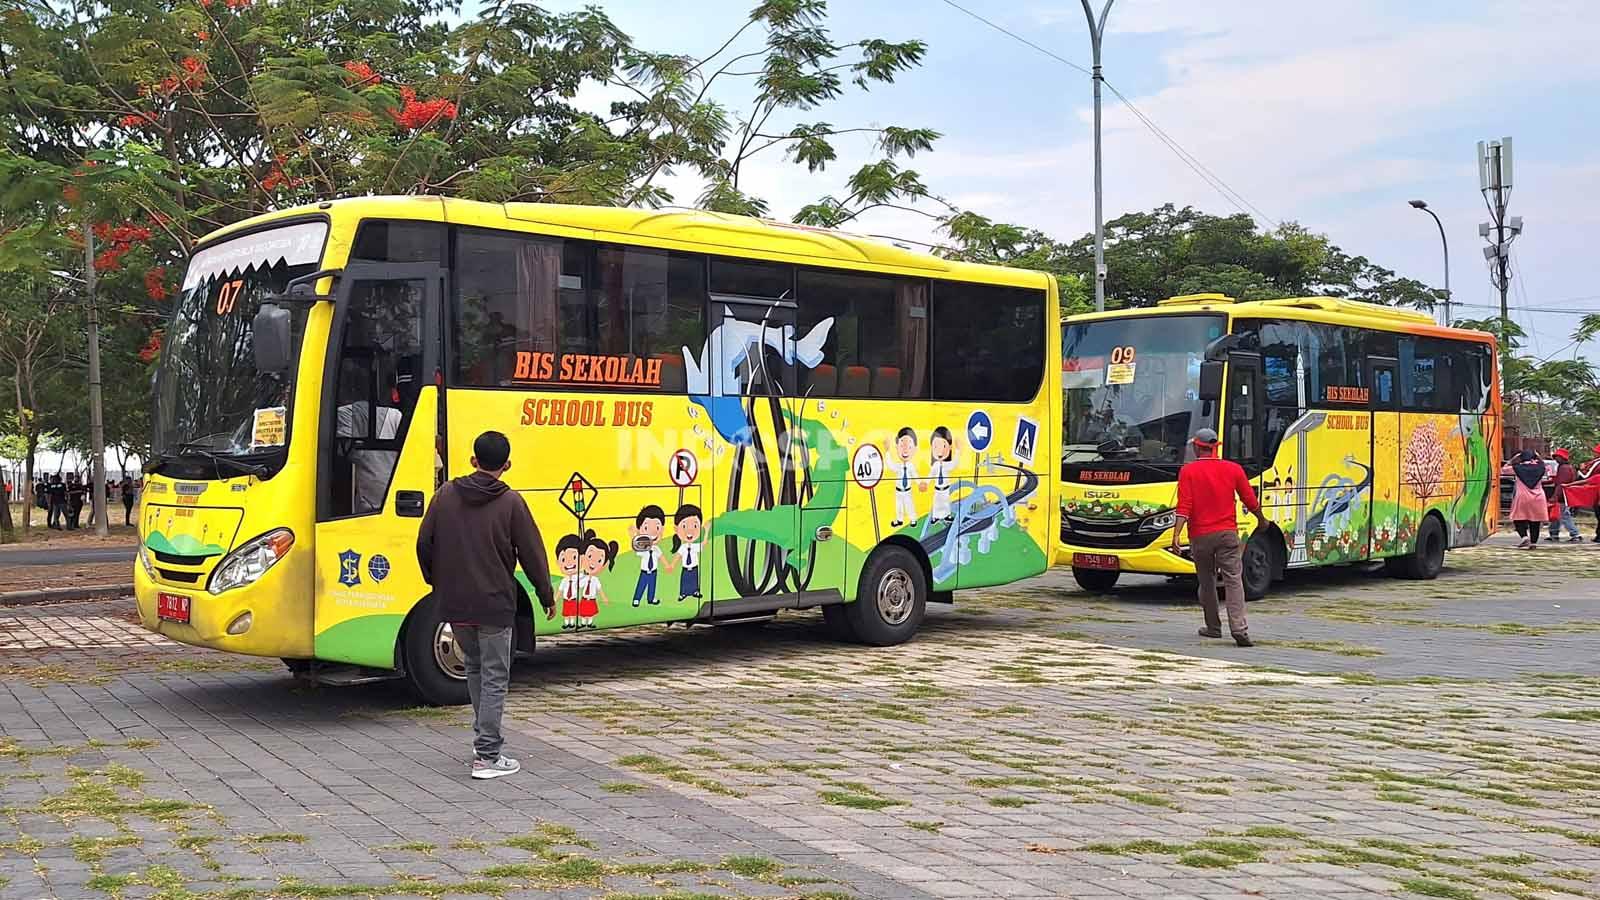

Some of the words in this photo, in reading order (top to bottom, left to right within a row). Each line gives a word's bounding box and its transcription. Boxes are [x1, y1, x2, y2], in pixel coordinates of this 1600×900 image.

[216, 280, 243, 315] 07
[1111, 346, 1135, 364] 09
[513, 351, 555, 380] BIS
[559, 353, 663, 385] SEKOLAH
[521, 398, 606, 427] SCHOOL
[612, 400, 654, 427] BUS
[1327, 415, 1353, 430] SCHOOL
[1355, 416, 1369, 430] BUS
[857, 461, 872, 478] 40
[1084, 490, 1120, 499] ISUZU
